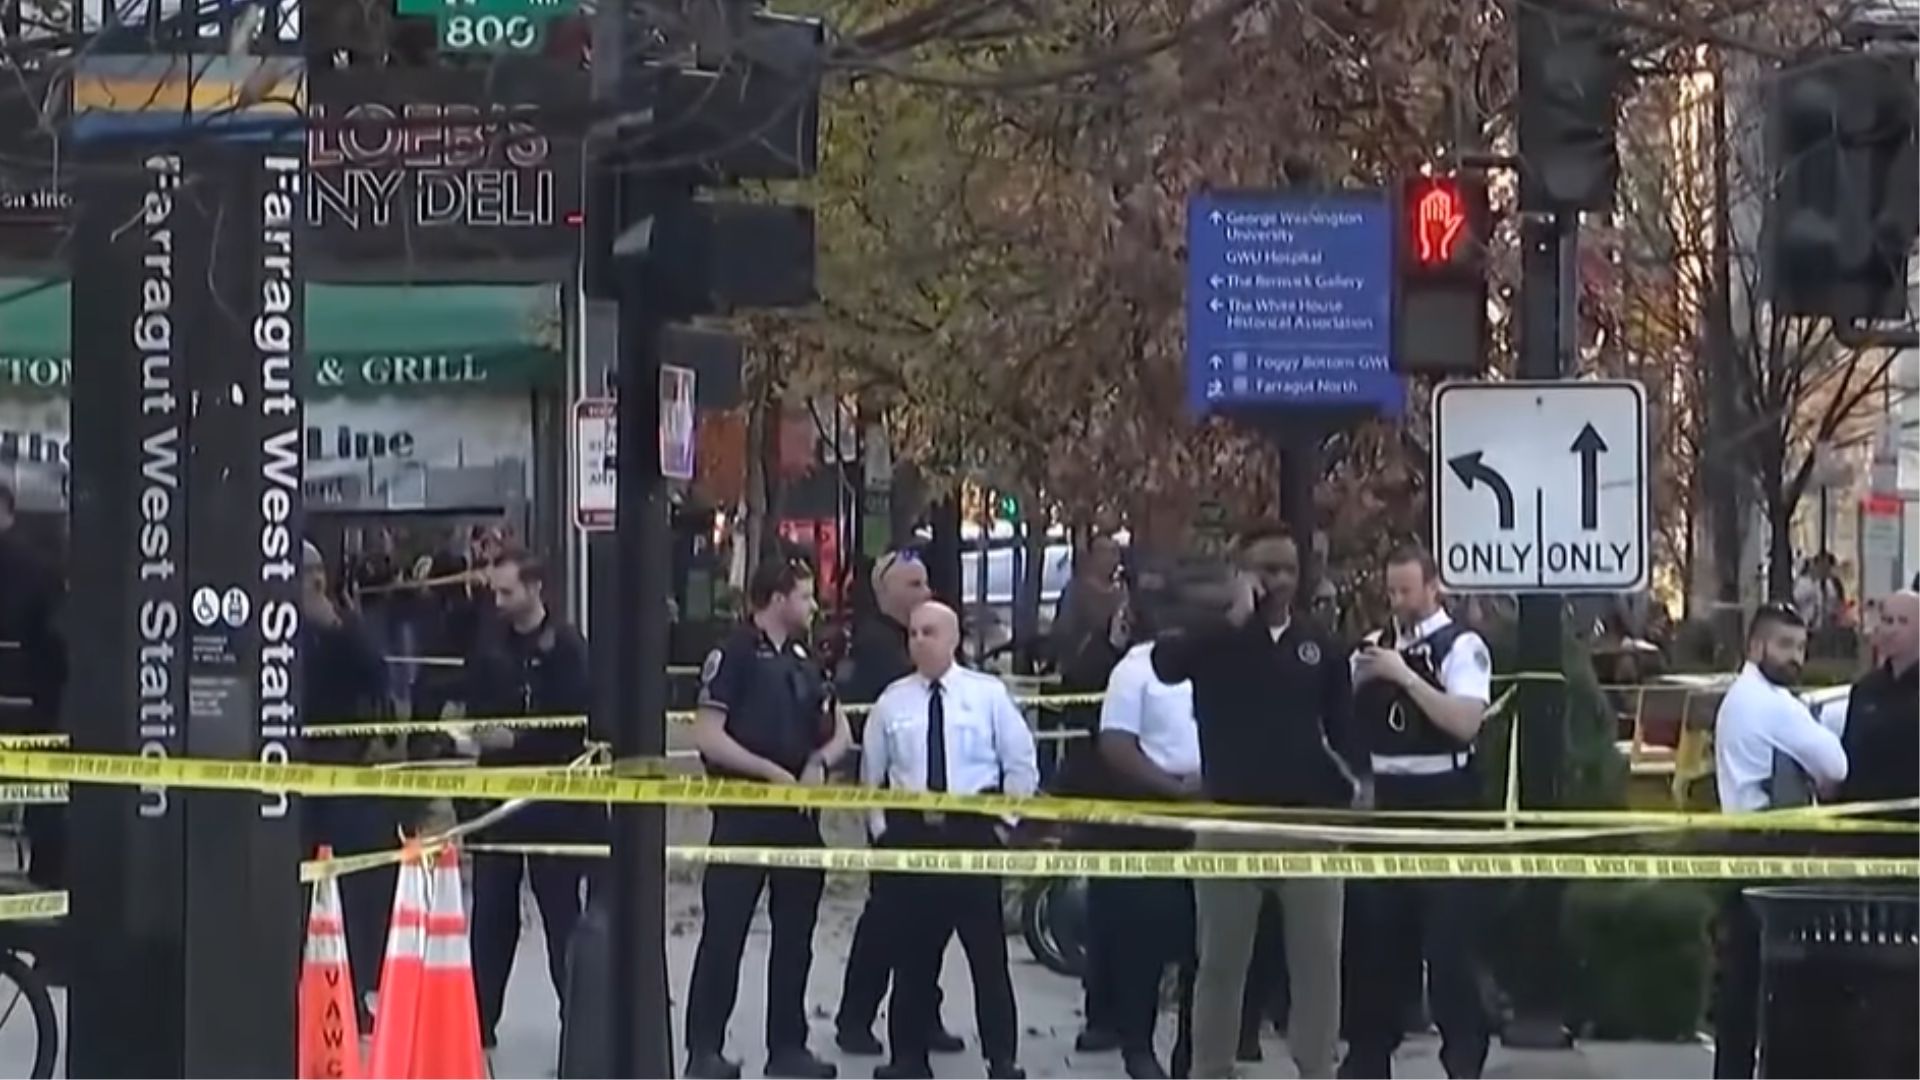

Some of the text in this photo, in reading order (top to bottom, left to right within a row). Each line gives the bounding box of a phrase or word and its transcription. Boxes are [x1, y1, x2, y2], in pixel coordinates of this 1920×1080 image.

[446, 15, 535, 48] 800
[308, 104, 549, 167] LOEB'S
[307, 168, 553, 230] NY DELI
[1226, 211, 1277, 228] George
[1226, 227, 1294, 243] University
[1226, 250, 1323, 266] GWU Hospital
[134, 155, 181, 415] Farragut
[254, 156, 300, 416] Farragut
[1227, 275, 1252, 288] The
[1228, 299, 1252, 312] The
[1299, 299, 1343, 312] House
[317, 354, 488, 386] & GRILL
[1256, 378, 1358, 394] Farragut North
[142, 426, 178, 581] West
[262, 428, 298, 582] West
[1449, 542, 1532, 573] ONLY
[1548, 542, 1631, 573] ONLY
